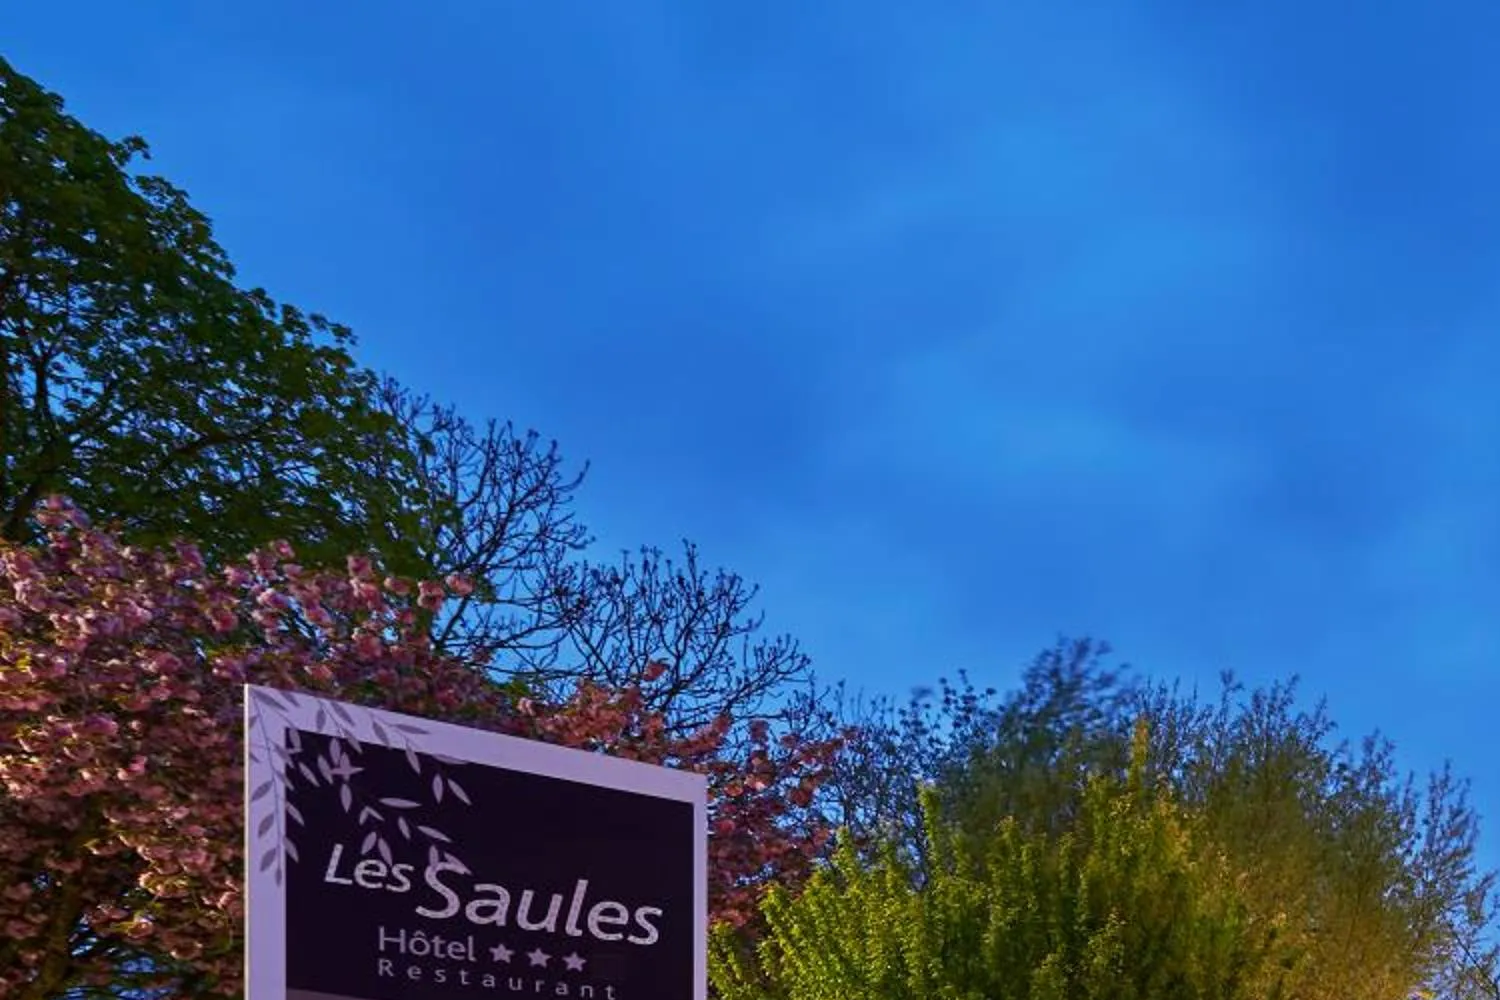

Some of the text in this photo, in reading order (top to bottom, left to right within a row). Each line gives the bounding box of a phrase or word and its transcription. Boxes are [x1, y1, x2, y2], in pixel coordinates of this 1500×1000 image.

[324, 843, 663, 945] Les Saules
[378, 926, 477, 962] Hôtel
[378, 958, 616, 1000] Restaurant
